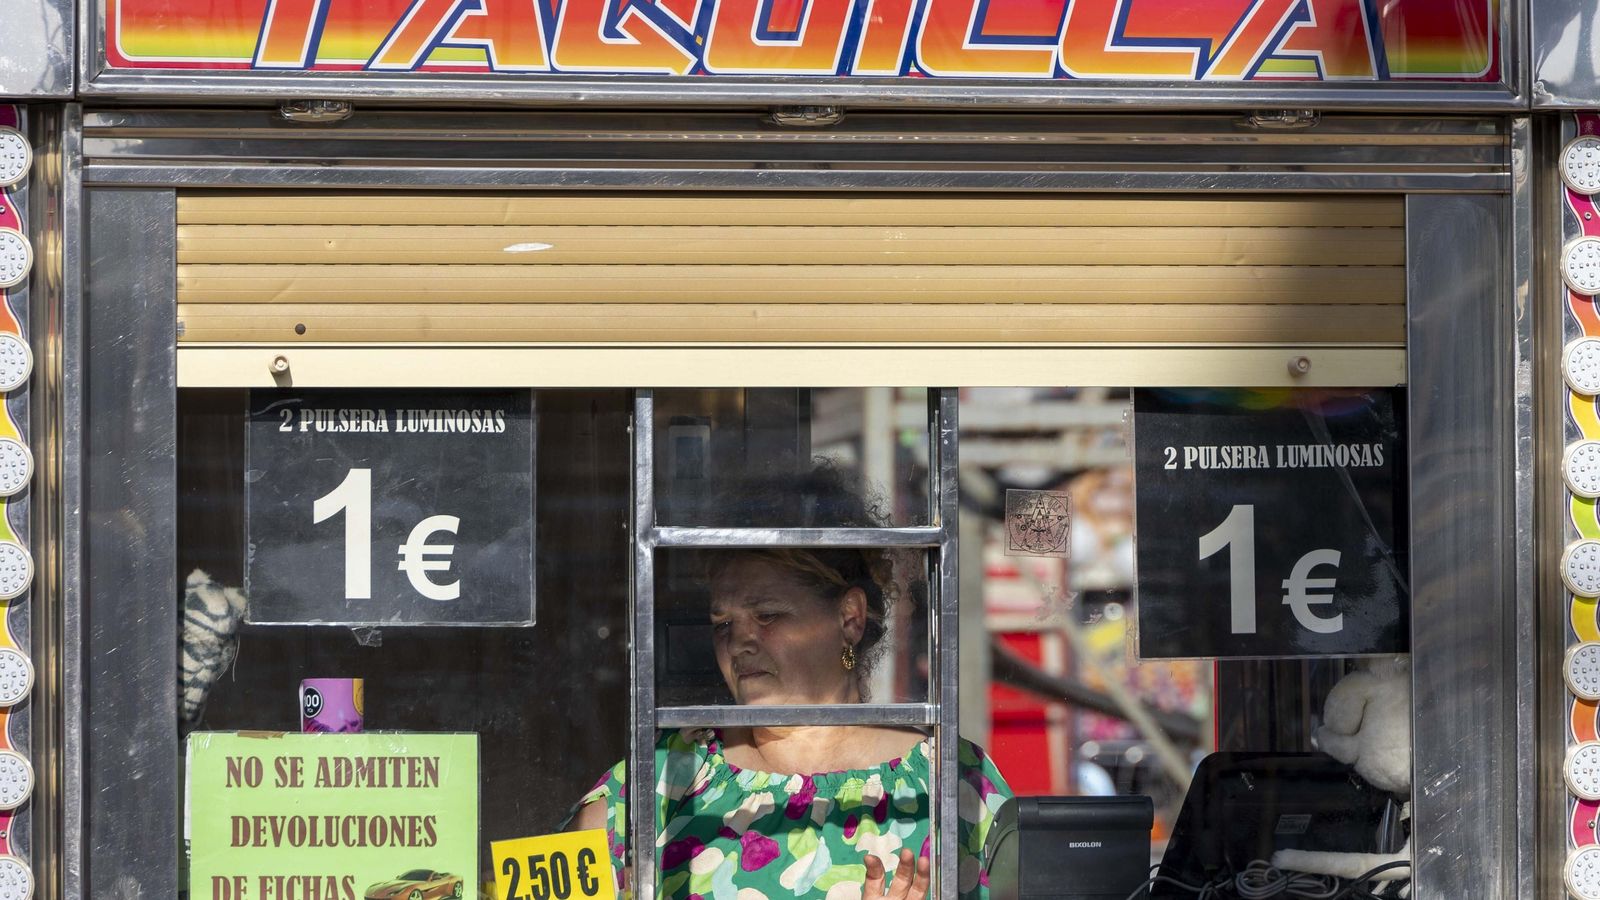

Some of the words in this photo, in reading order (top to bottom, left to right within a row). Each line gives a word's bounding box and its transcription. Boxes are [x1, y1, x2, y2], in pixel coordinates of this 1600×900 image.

[279, 409, 293, 432] 2
[300, 409, 389, 432] PULSERA
[395, 409, 506, 433] LUMINOSAS
[1164, 446, 1177, 470] 2
[1184, 445, 1270, 469] PULSERA
[1276, 443, 1384, 468] LUMINOSAS
[313, 468, 372, 599] 1
[397, 515, 461, 600] €
[1199, 504, 1256, 634] 1
[1281, 548, 1344, 634] €
[225, 756, 264, 788] NO
[274, 756, 304, 788] SE
[314, 756, 440, 788] ADMITEN
[230, 815, 438, 848] DEVOLUCIONES
[211, 875, 248, 900] DE
[258, 875, 355, 900] FICHAS
[576, 847, 599, 897] €
